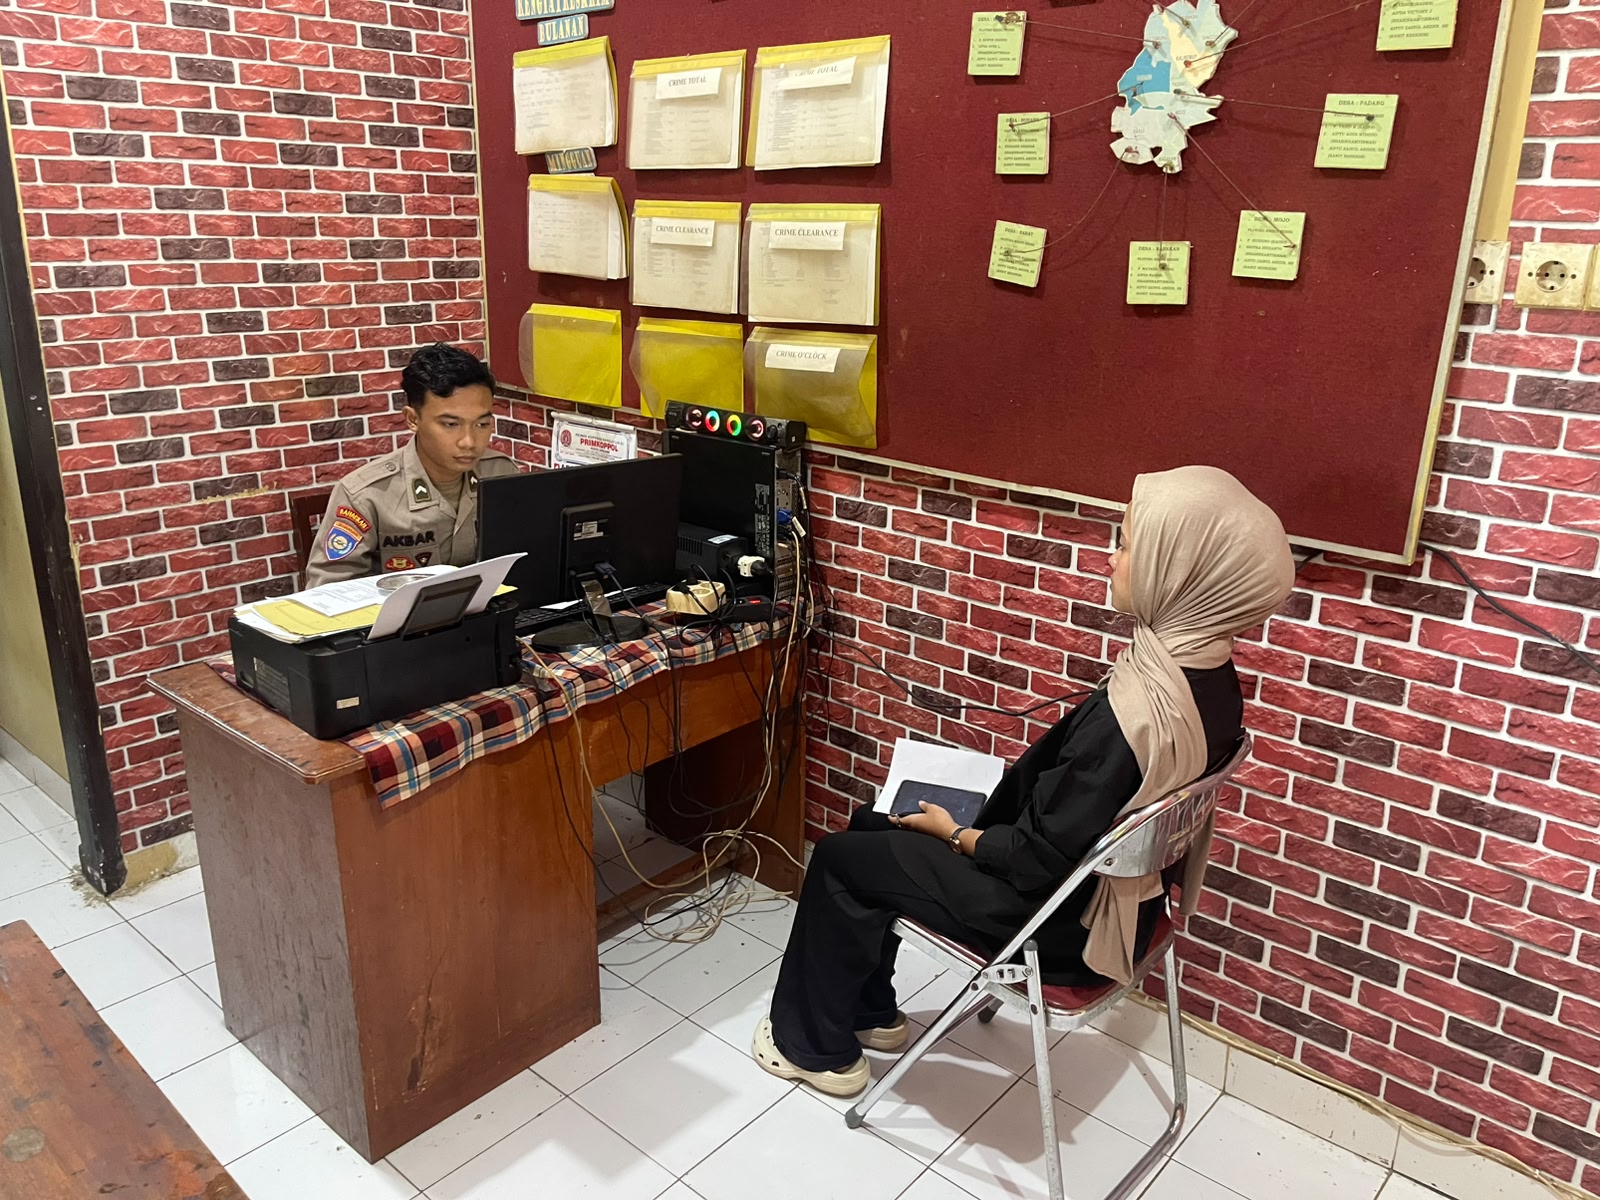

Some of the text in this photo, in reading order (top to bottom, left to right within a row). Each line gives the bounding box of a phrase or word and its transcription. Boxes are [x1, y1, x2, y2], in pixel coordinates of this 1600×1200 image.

[539, 16, 584, 42] BULANAN
[668, 76, 707, 87] CRIME TOTAL
[546, 149, 593, 172] MINGGUAN
[655, 225, 709, 235] CRIME CLEARANCE
[775, 228, 839, 237] CRIME CLEARANCE
[776, 350, 795, 358] CRIME
[580, 438, 619, 452] PRIMKOPPOL
[382, 530, 435, 547] AKBAR
